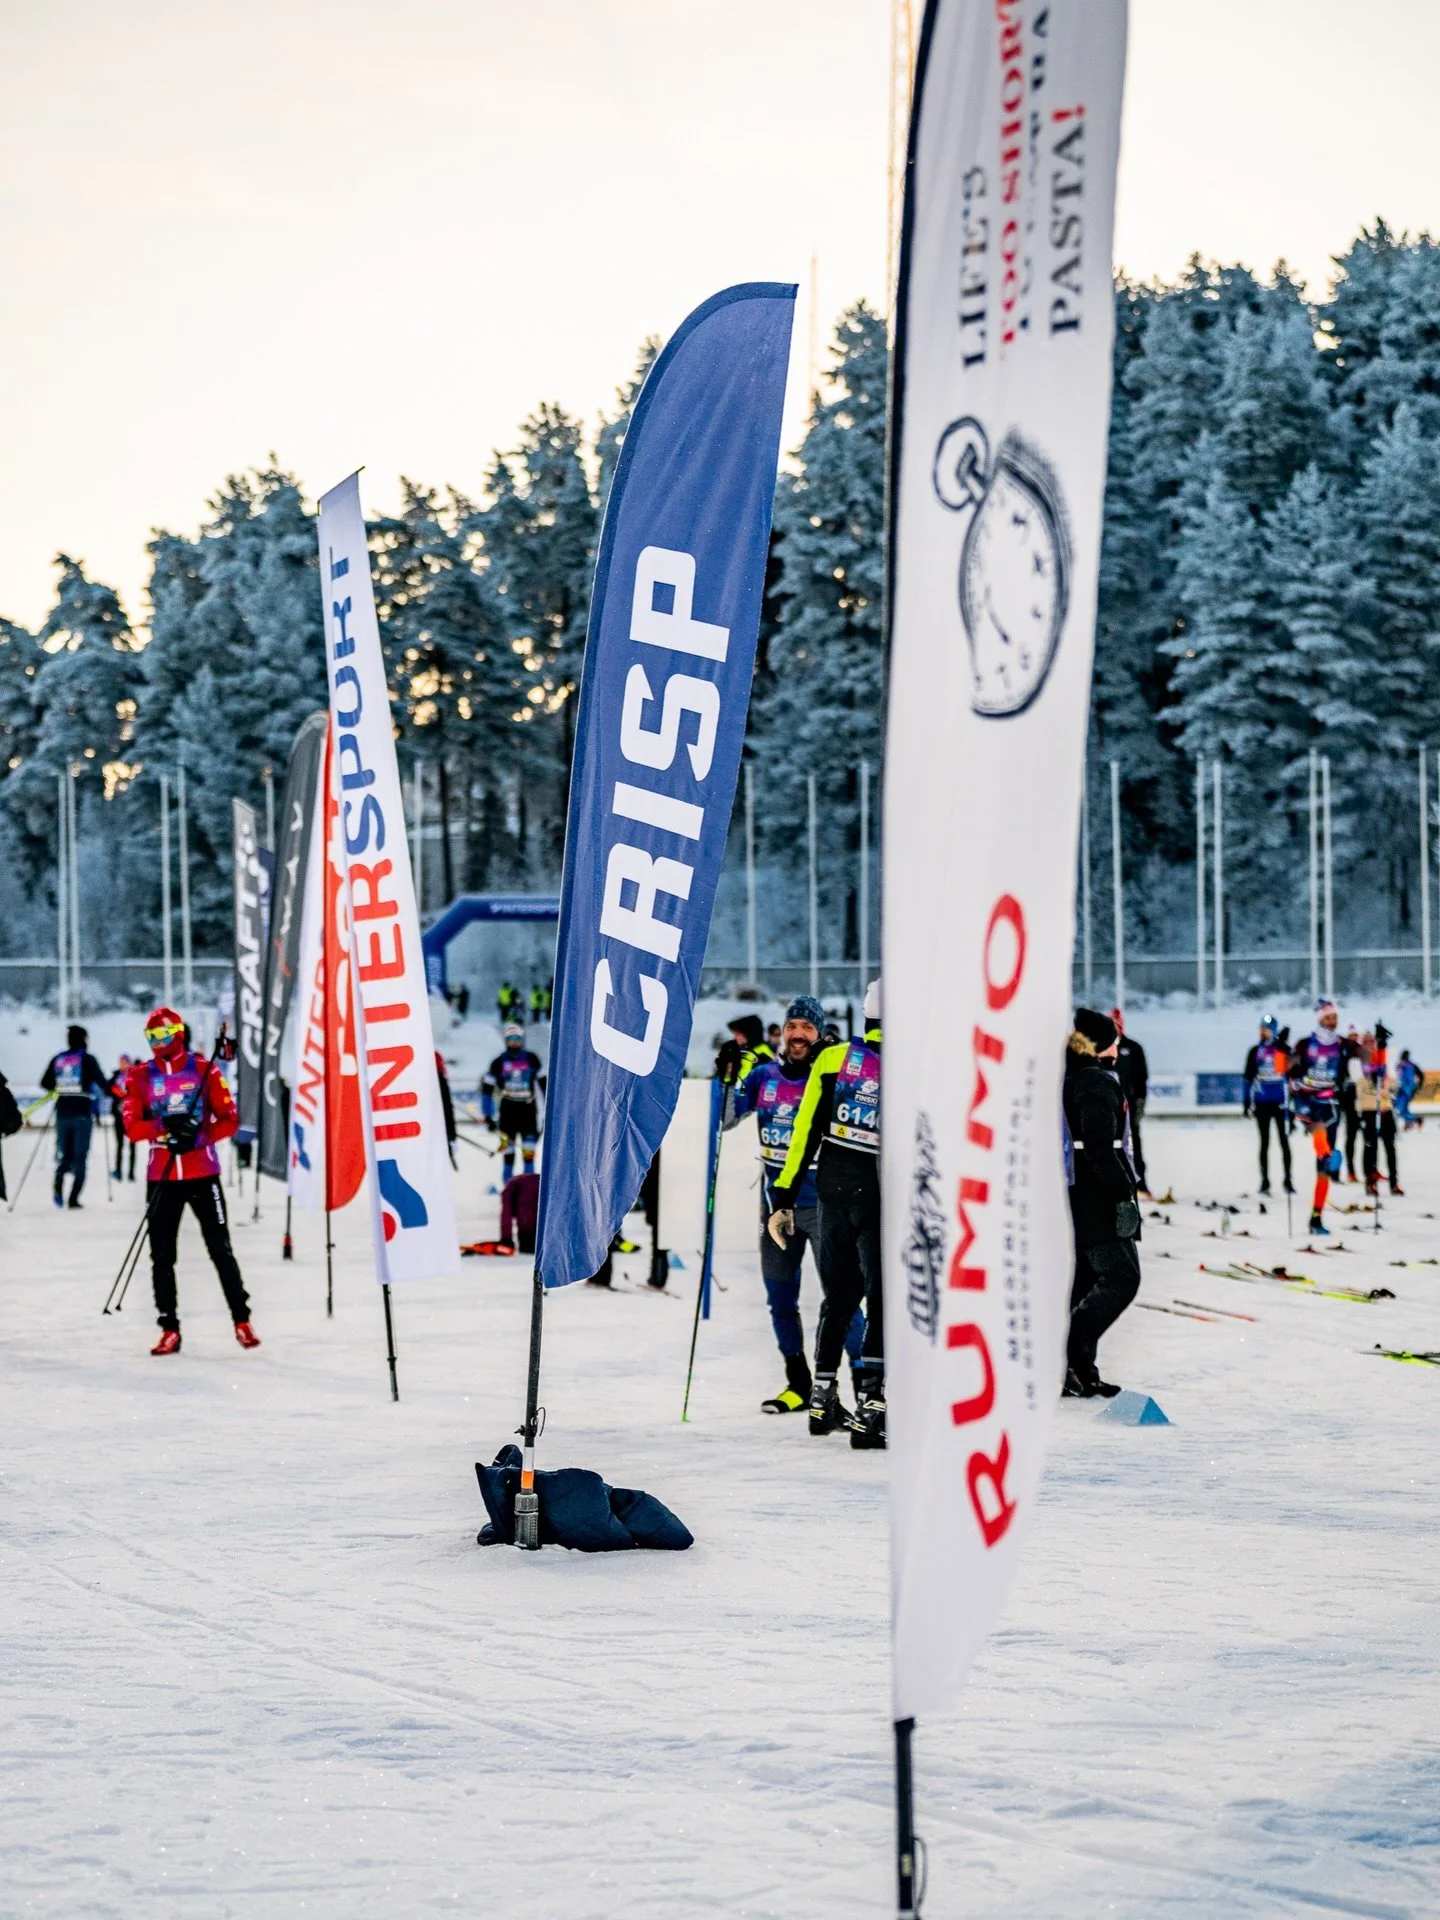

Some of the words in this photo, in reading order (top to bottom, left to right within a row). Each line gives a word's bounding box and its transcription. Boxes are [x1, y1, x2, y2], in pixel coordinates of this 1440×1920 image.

[1048, 103, 1088, 338] PASTA!
[236, 880, 263, 1070] CRAFT
[329, 546, 422, 1142] INTERSPORT
[590, 545, 730, 1077] CRISP
[946, 893, 1027, 1549] RUMMO
